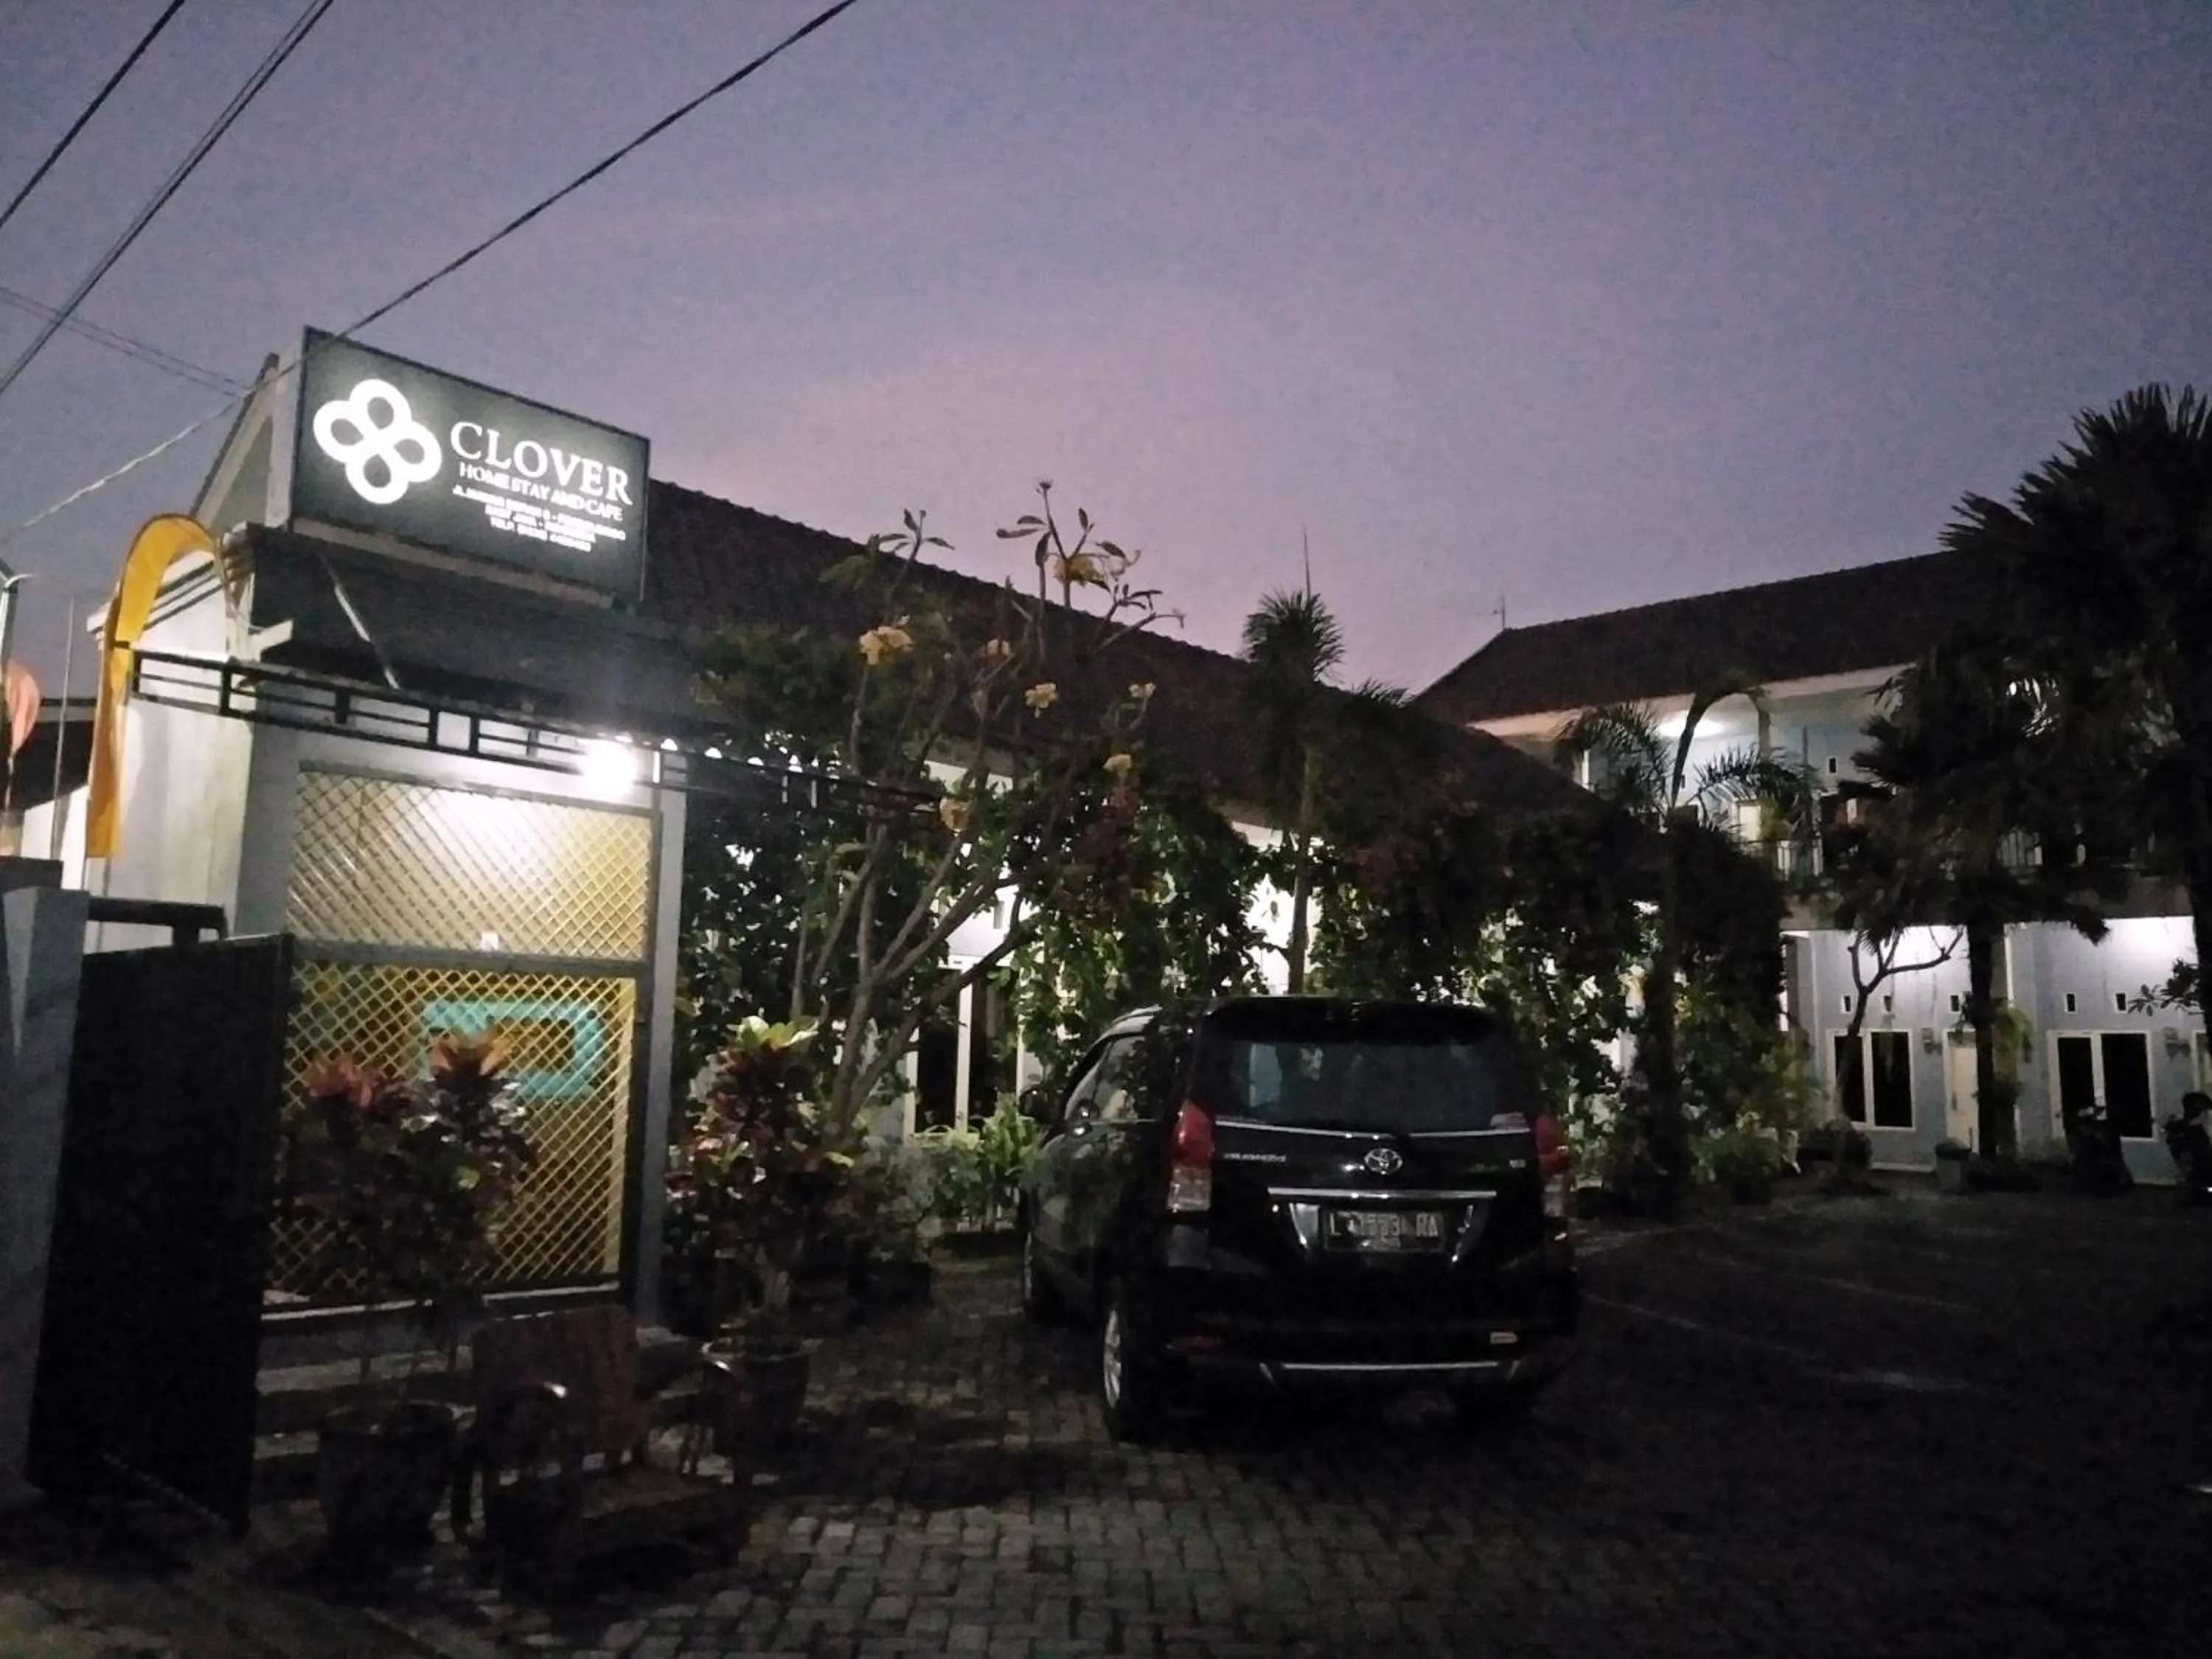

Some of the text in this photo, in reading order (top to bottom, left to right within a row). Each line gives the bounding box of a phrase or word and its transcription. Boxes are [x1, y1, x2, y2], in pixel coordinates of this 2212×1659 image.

[451, 421, 633, 505] CLOVER
[460, 462, 509, 489] HOME
[512, 477, 550, 500] STAY
